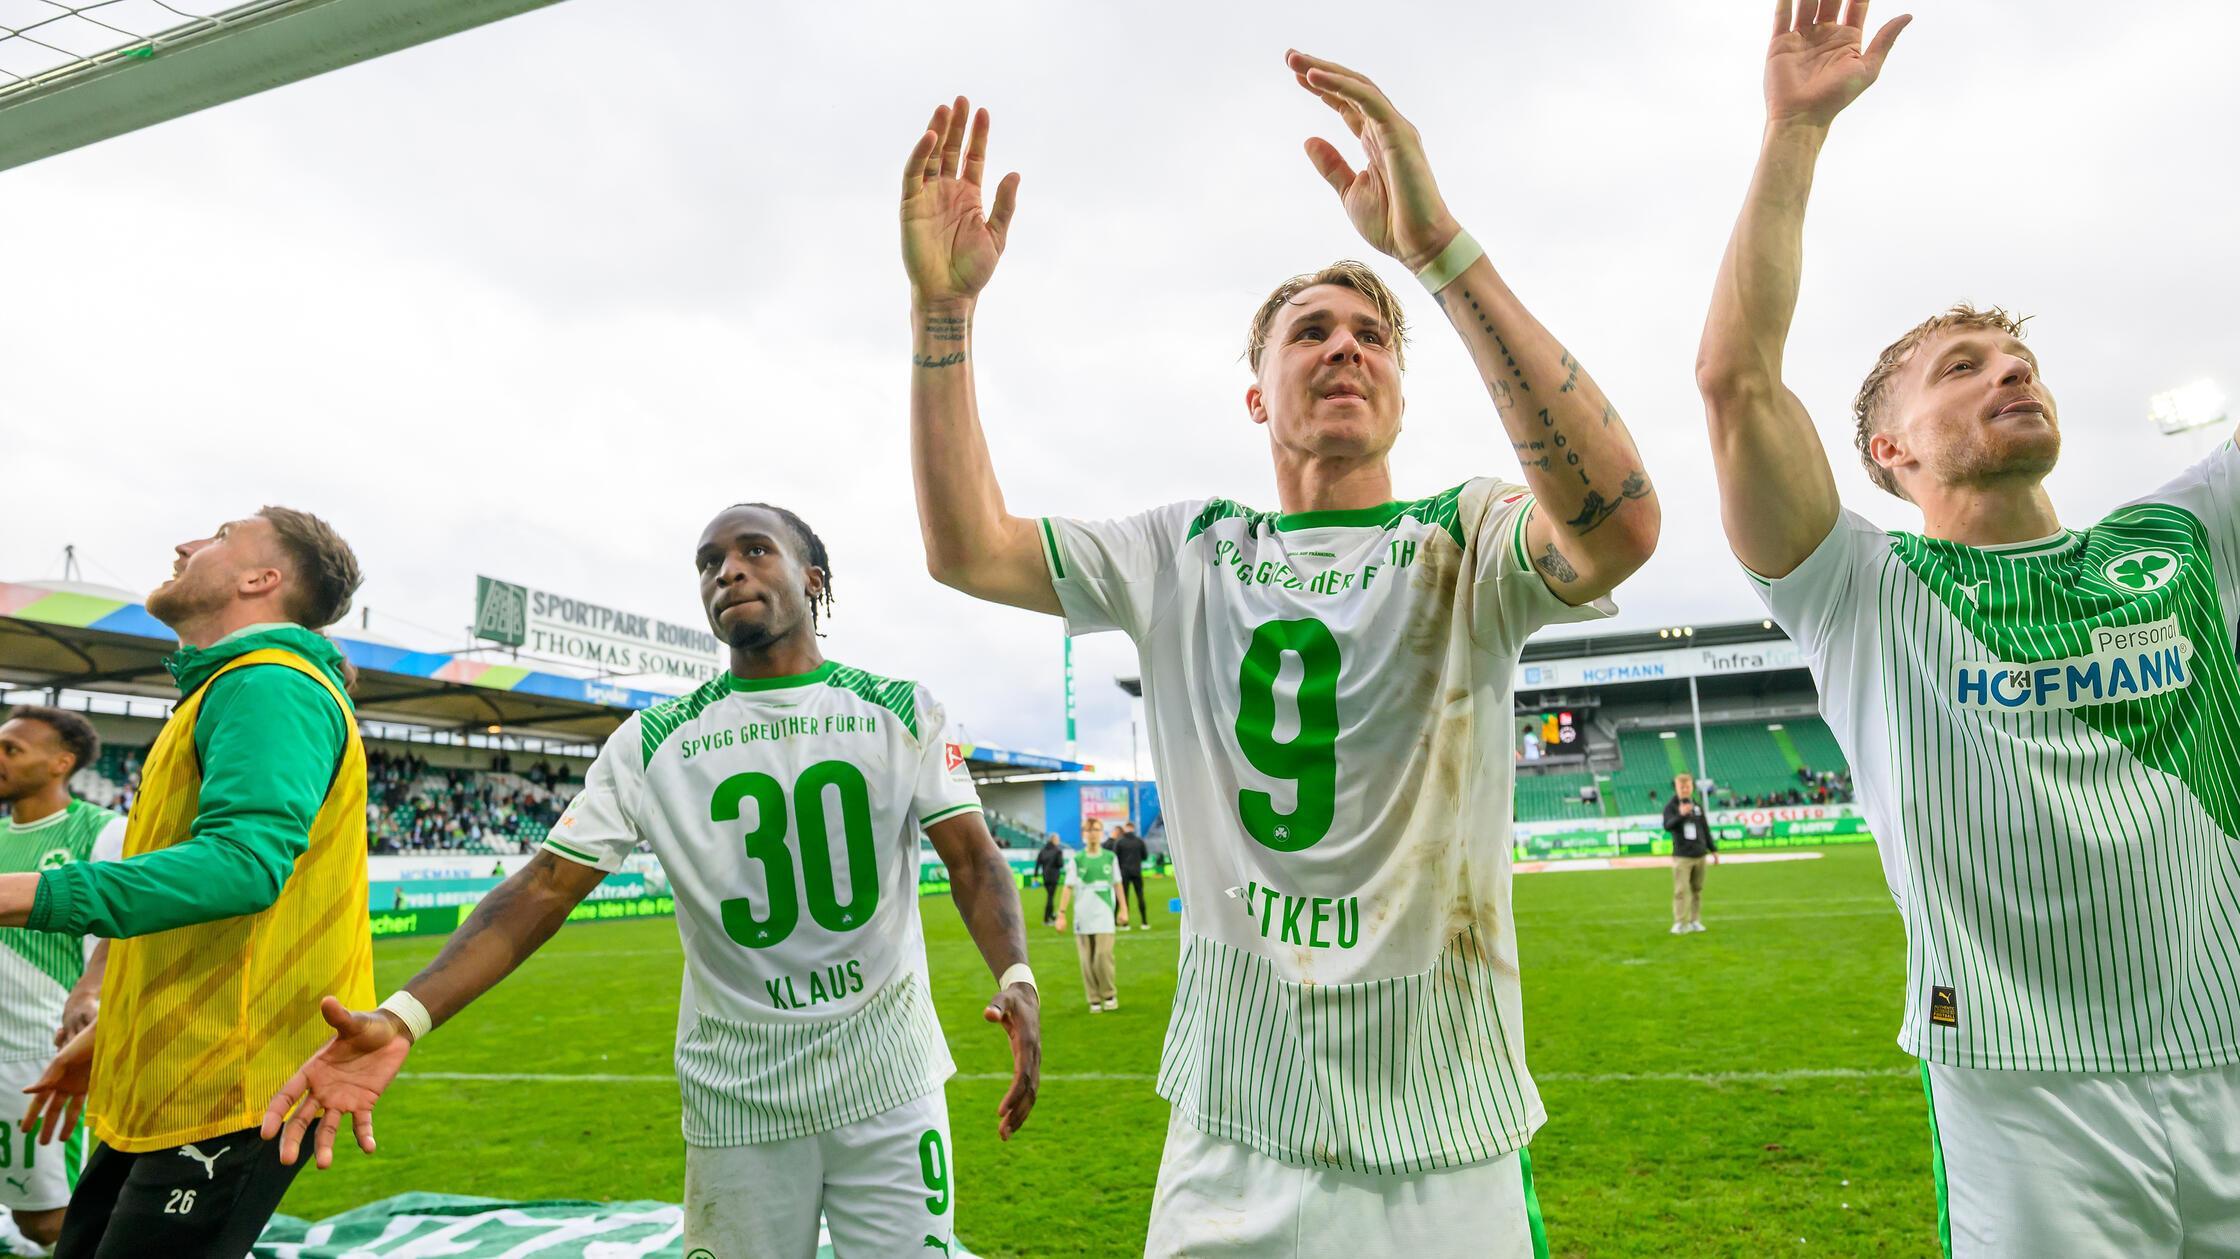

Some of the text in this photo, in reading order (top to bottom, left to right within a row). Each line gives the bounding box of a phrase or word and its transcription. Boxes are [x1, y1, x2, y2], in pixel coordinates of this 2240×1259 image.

[1214, 540, 1253, 586] SPVG
[1363, 540, 1416, 590] FTH
[532, 591, 649, 640] SPORTPARK
[2098, 622, 2177, 652] Personal
[532, 629, 631, 666] THOMAS
[1712, 651, 1764, 670] infra
[1583, 664, 1665, 683] HOFMANN
[1958, 645, 2185, 707] HOFMANN
[682, 714, 875, 759] SPVGG GREUTHER FÜRTH
[1235, 617, 1342, 853] 9
[711, 760, 880, 949] 30
[766, 960, 864, 1010] KLAUS
[919, 1129, 949, 1216] 9
[164, 1189, 197, 1214] 26
